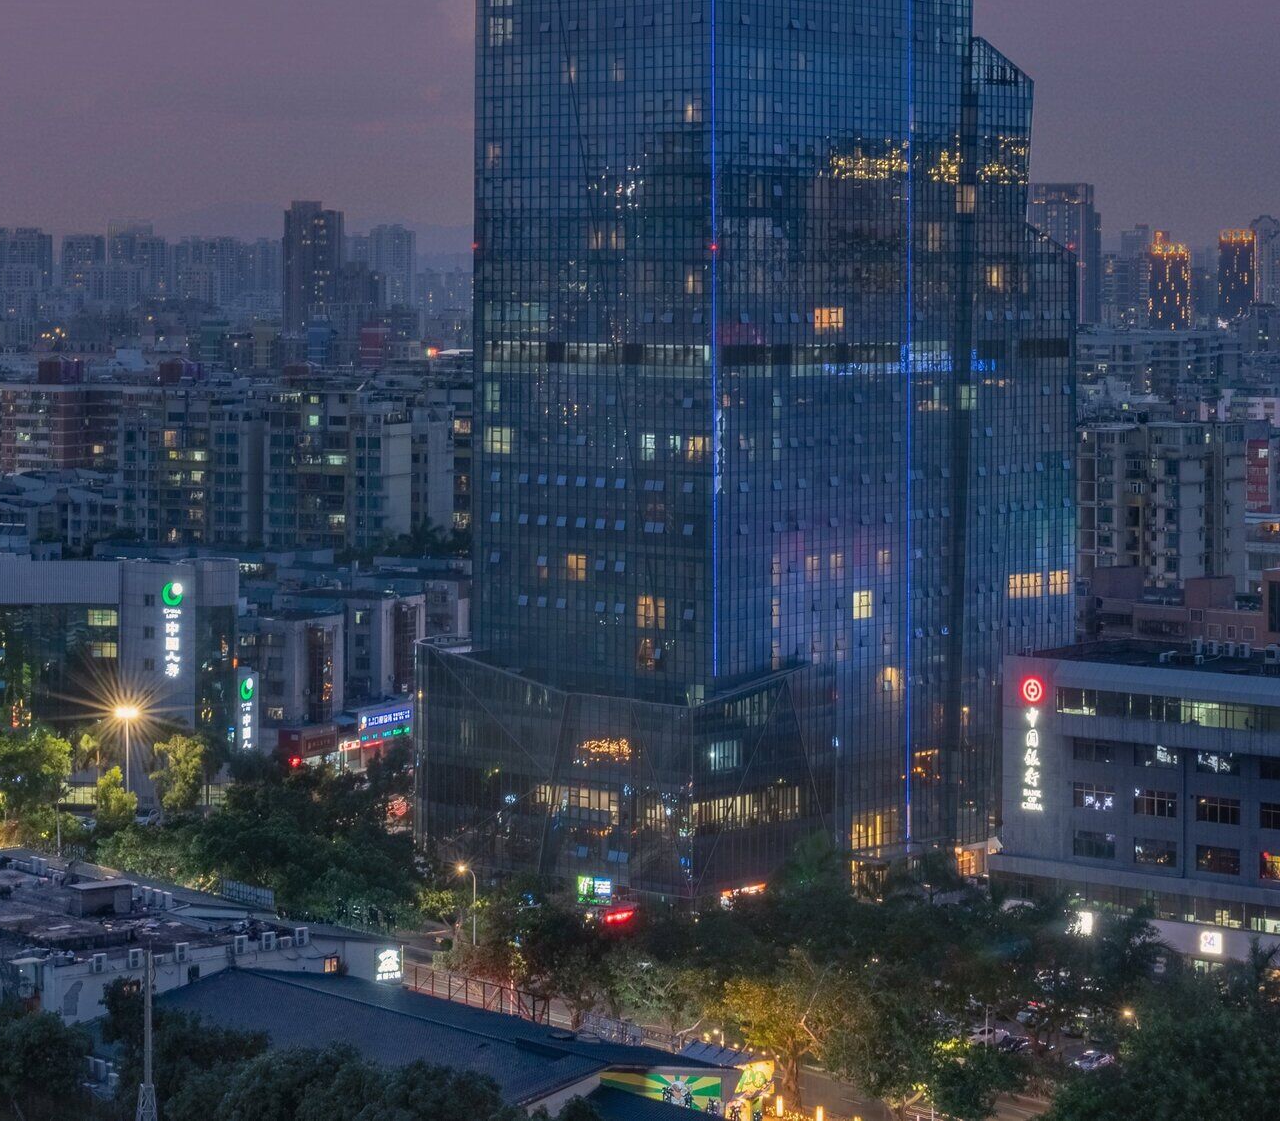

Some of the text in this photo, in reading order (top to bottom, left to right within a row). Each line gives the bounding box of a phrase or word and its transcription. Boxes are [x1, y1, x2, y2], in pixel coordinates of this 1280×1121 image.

[1024, 707, 1040, 787] 中国银行
[1023, 788, 1041, 798] BANK
[1021, 801, 1043, 811] CHINA
